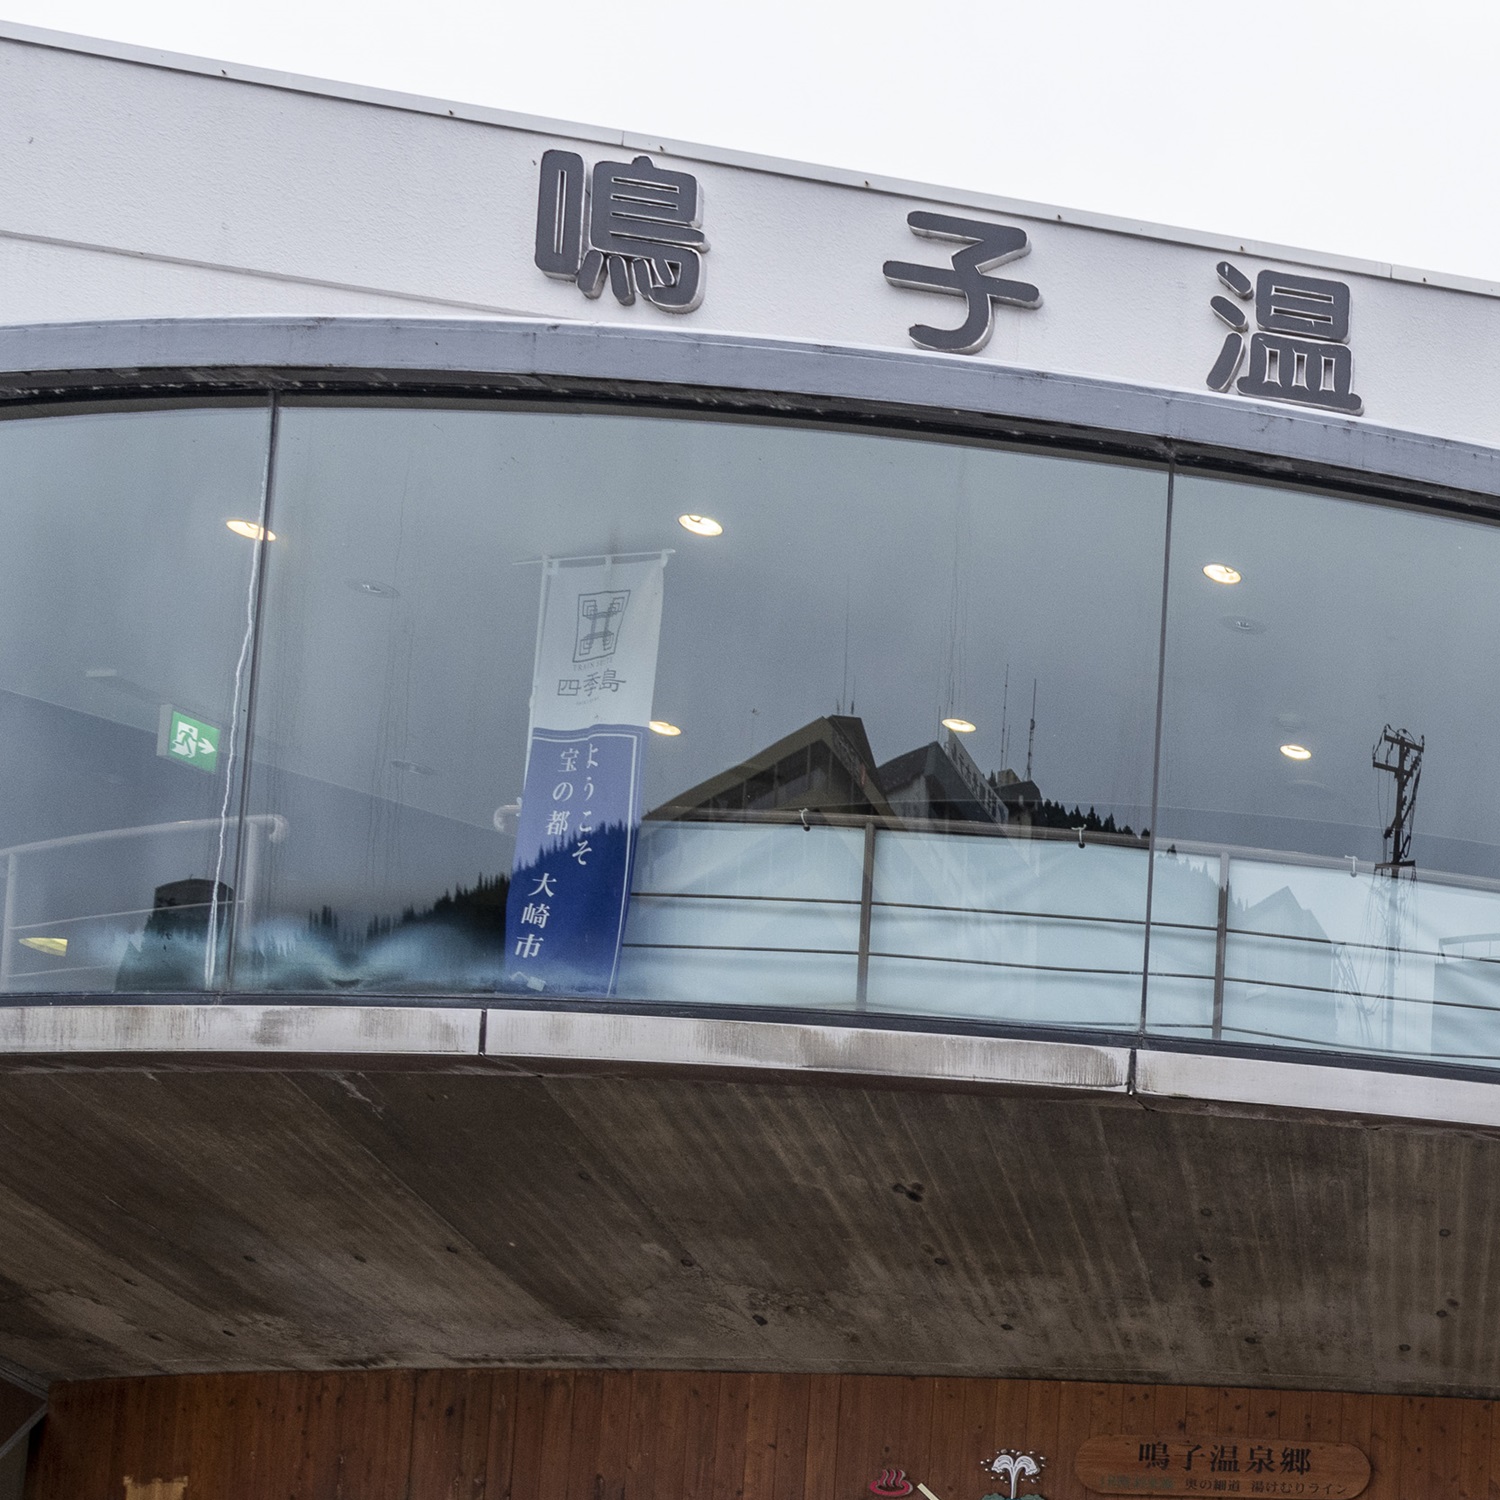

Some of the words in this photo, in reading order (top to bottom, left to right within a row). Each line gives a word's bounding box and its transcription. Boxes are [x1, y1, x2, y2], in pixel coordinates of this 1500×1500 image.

[557, 668, 626, 697] 四季島
[546, 748, 579, 836] 宝の都
[572, 743, 599, 866] ようこそ
[1139, 1441, 1311, 1476] 鳴子温泉郷
[1186, 1478, 1241, 1493] 奥の細道
[1251, 1479, 1347, 1496] 湯けむりライン
